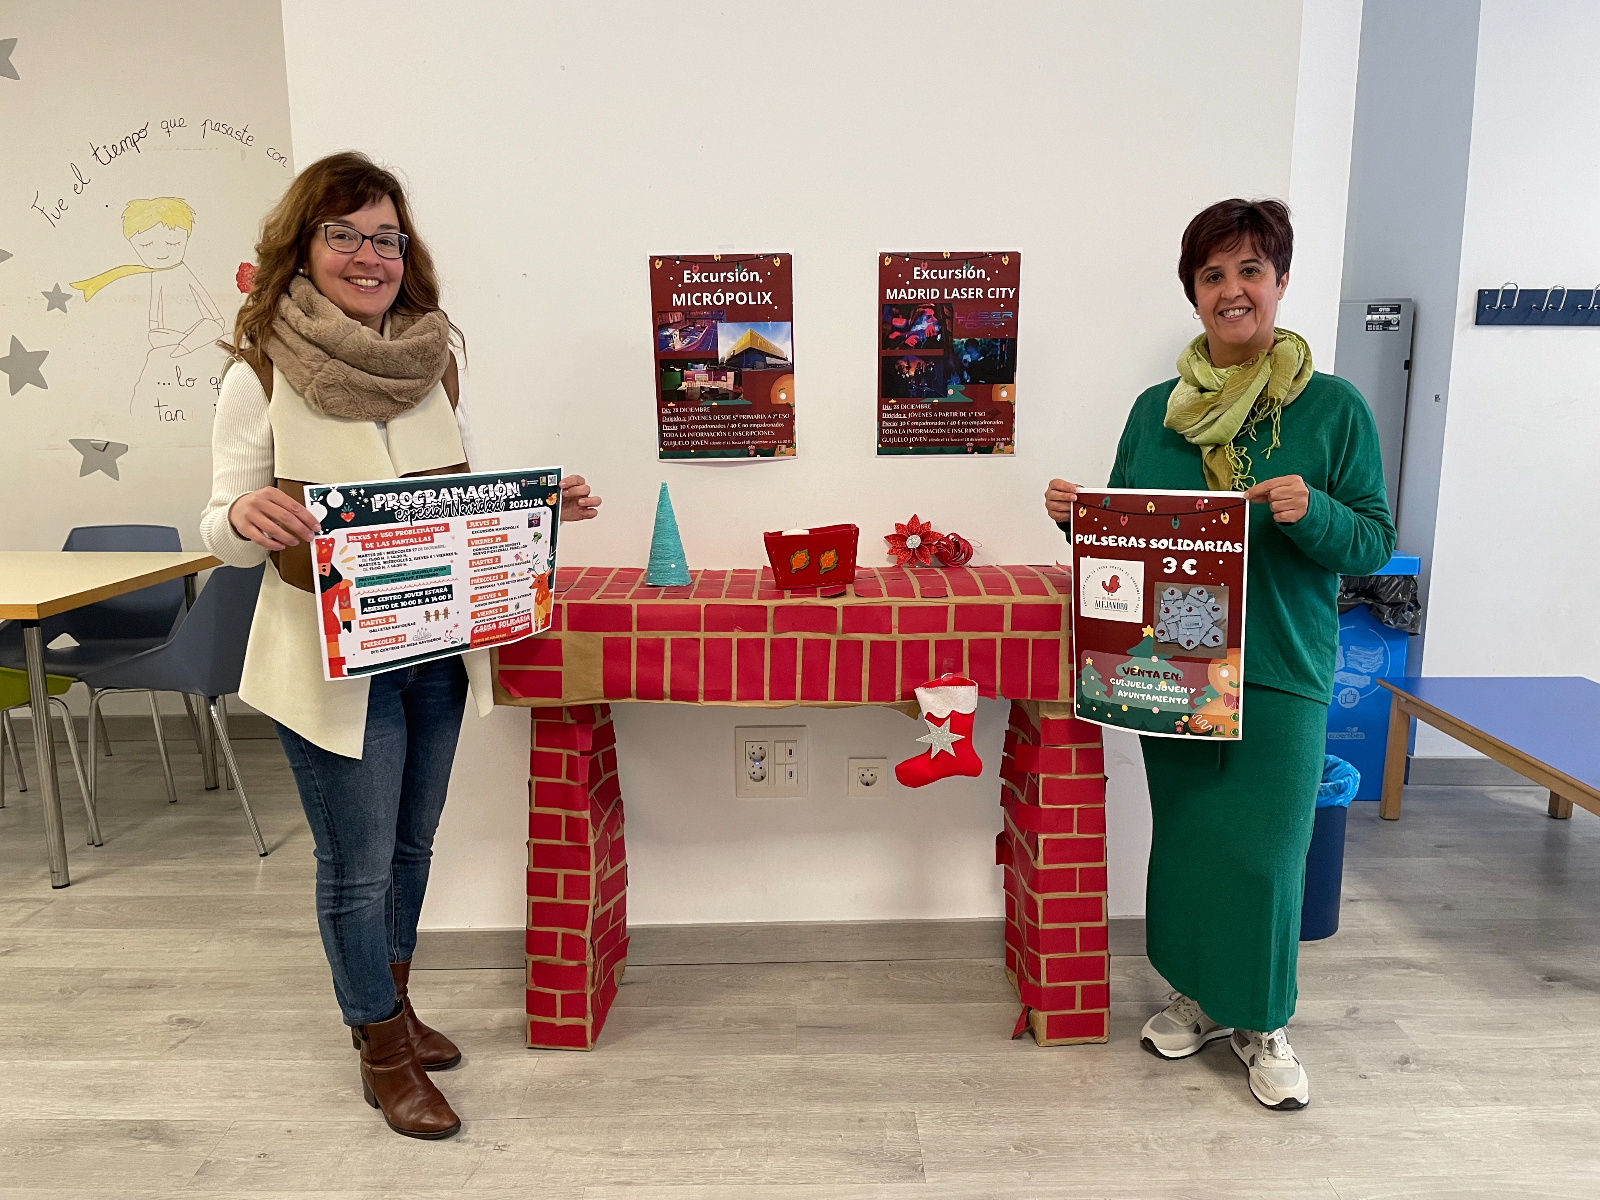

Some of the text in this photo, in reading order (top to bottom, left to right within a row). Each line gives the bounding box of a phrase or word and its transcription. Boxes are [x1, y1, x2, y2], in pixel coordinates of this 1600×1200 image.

[31, 117, 287, 228] Fue el tiempo que pasaste con
[683, 268, 760, 284] Excursión
[913, 265, 986, 280] Excursión
[672, 289, 773, 307] MICRÓPOLIX
[886, 287, 1016, 299] MADRID LASER CITY
[153, 397, 187, 421] tan
[908, 411, 933, 419] JÓVENES
[882, 436, 909, 444] GUIJUELO
[909, 436, 927, 444] JOVEN
[508, 498, 544, 510] 2023/24
[469, 520, 490, 528] JUEVES
[376, 540, 390, 548] LAS
[392, 535, 432, 546] PANTALLAS
[1075, 534, 1243, 554] PULSERAS SOLIDARIAS
[471, 558, 493, 566] MARTES
[1162, 557, 1198, 575] 3 €
[404, 591, 423, 599] JOVEN
[424, 586, 448, 596] ESTARÁ
[363, 604, 390, 613] ABIERTO
[360, 618, 386, 627] MARTES
[474, 623, 497, 634] CAUSA
[498, 615, 530, 629] SOLIDARIA
[1122, 666, 1182, 681] VENTA EN:
[1155, 684, 1188, 693] JOVEN
[1118, 690, 1189, 704] AYUNTAMIENTO
